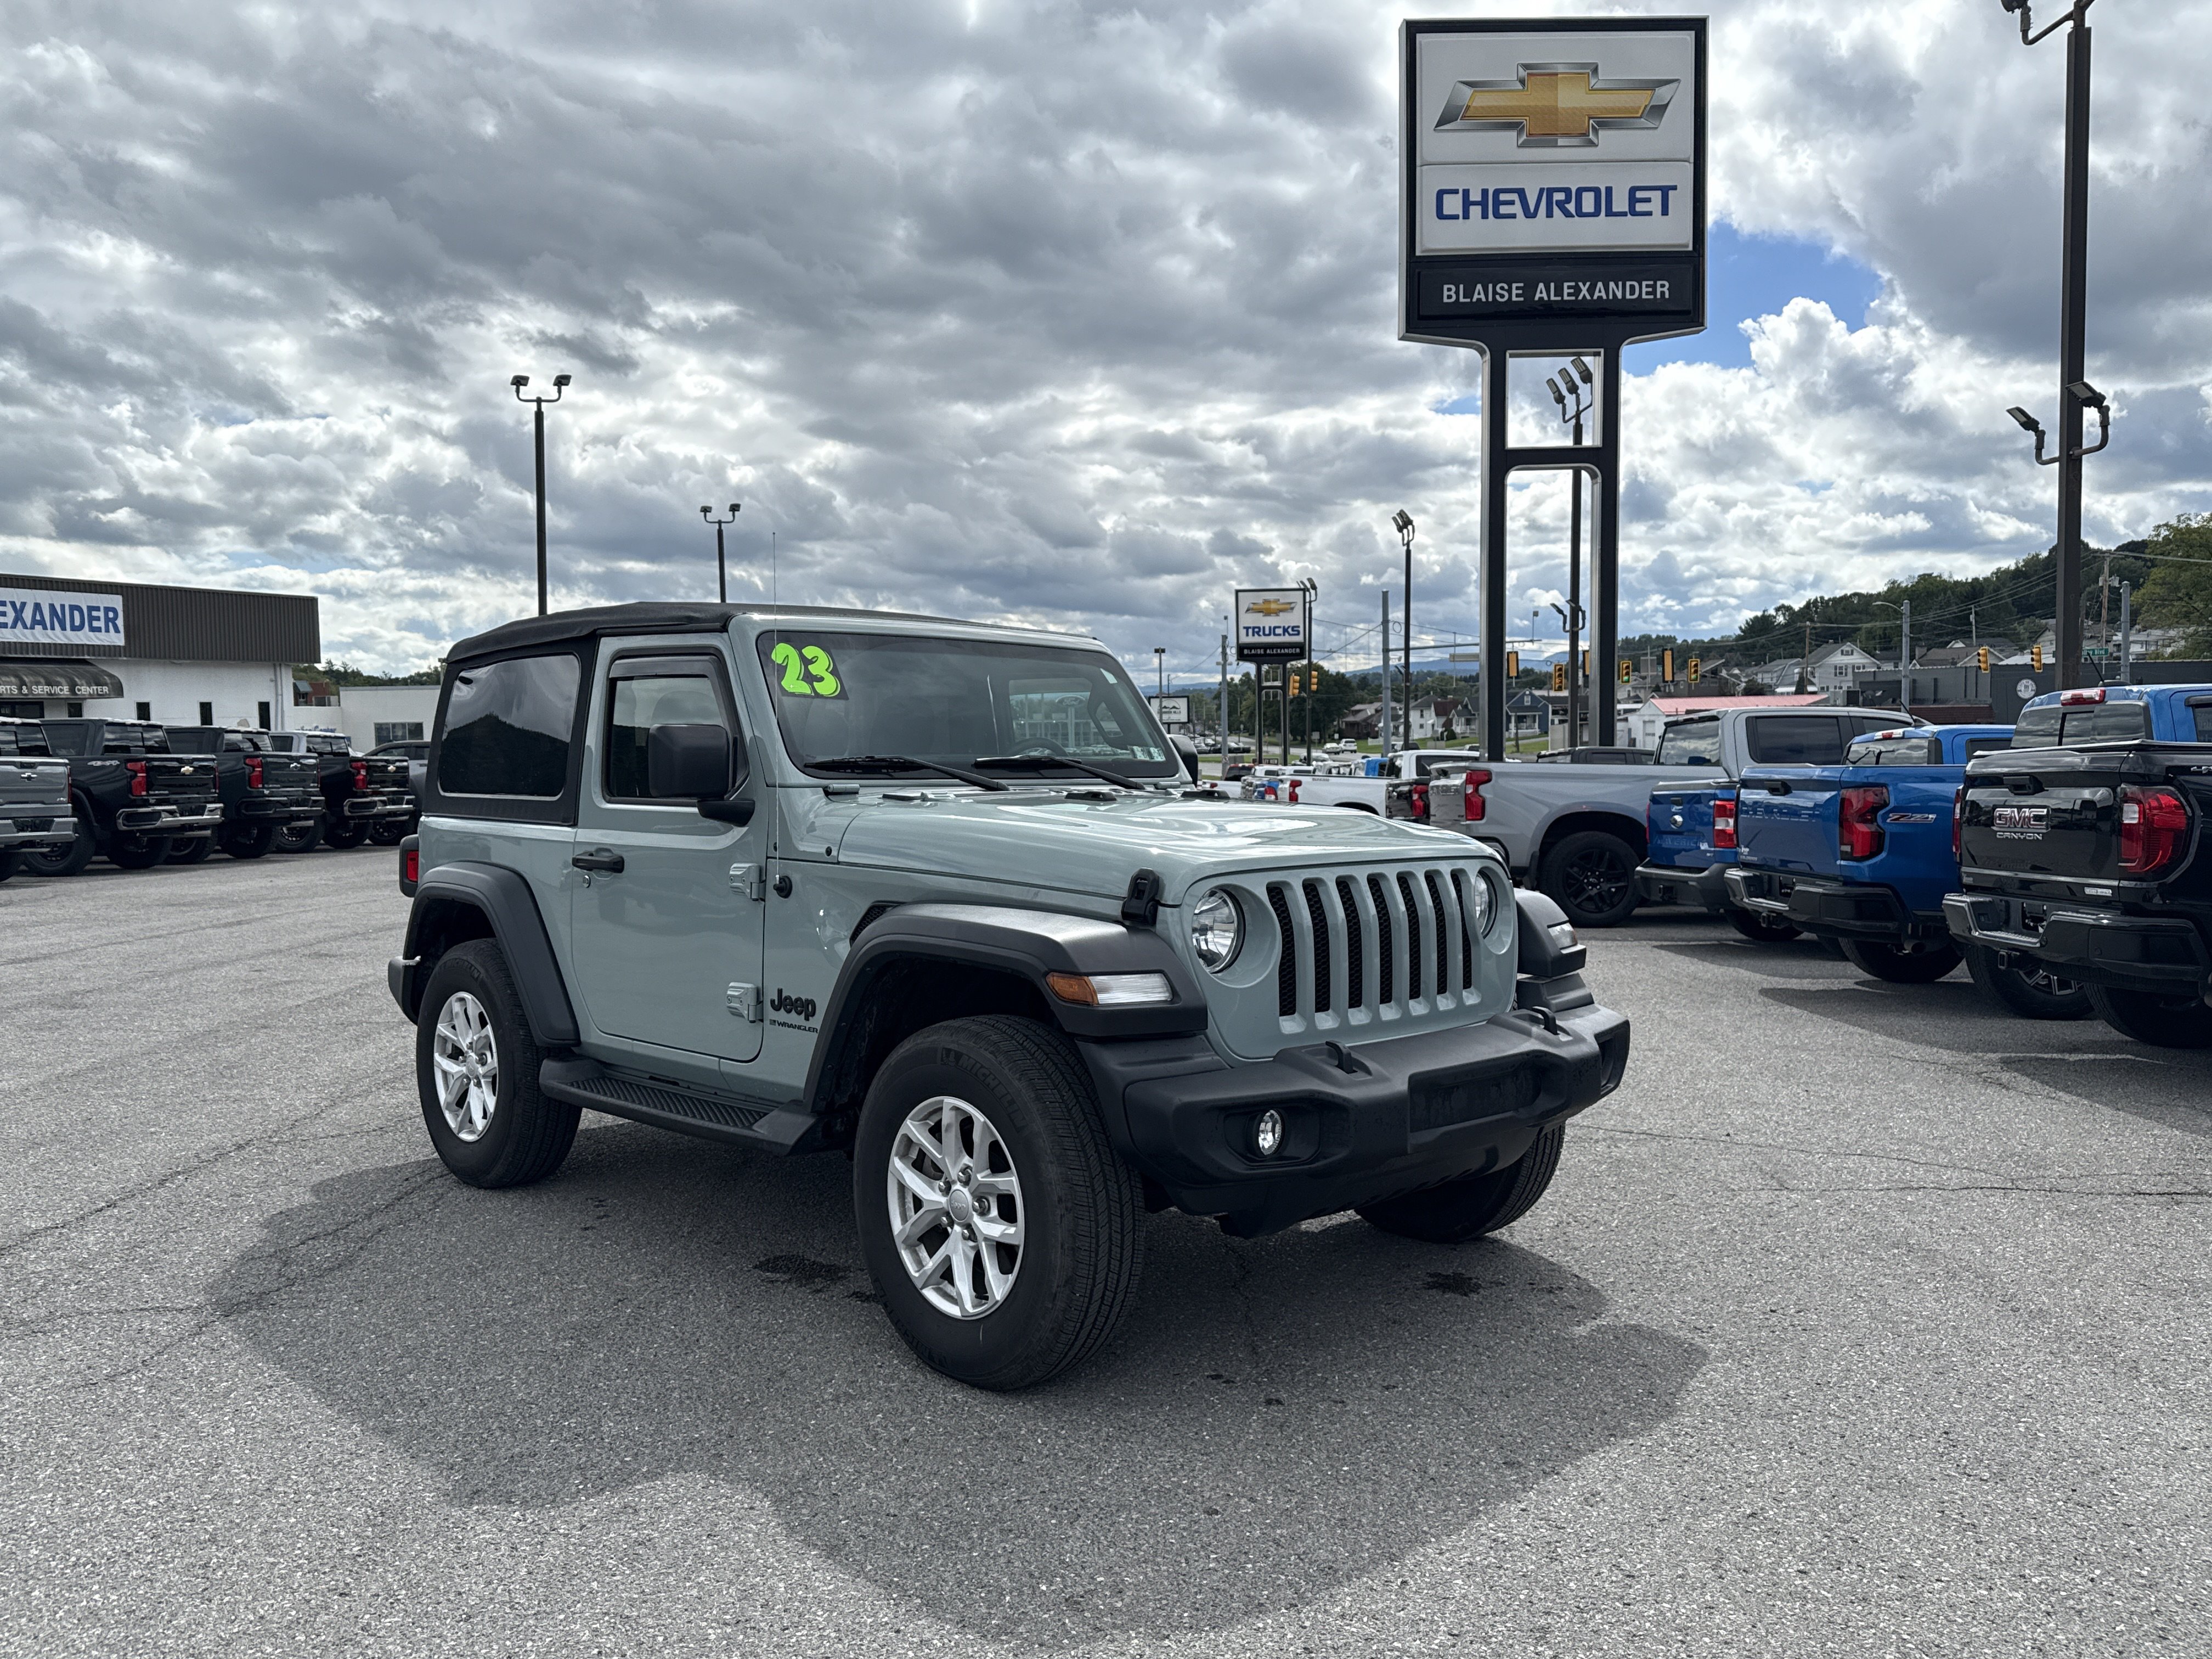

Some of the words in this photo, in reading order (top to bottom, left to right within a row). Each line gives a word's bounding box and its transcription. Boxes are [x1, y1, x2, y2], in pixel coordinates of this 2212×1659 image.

[1436, 185, 1678, 220] CHEVROLET
[1443, 282, 1524, 303] BLAISE
[1534, 280, 1670, 301] ALEXANDER
[1243, 625, 1300, 636] TRUCKS
[771, 642, 840, 697] 23
[32, 686, 70, 695] SERVICE
[75, 686, 110, 694] CENTER
[1994, 808, 2047, 828] GMC
[1996, 832, 2042, 840] CANYON
[770, 988, 816, 1022] Jeep
[777, 1020, 819, 1034] WRANGLER
